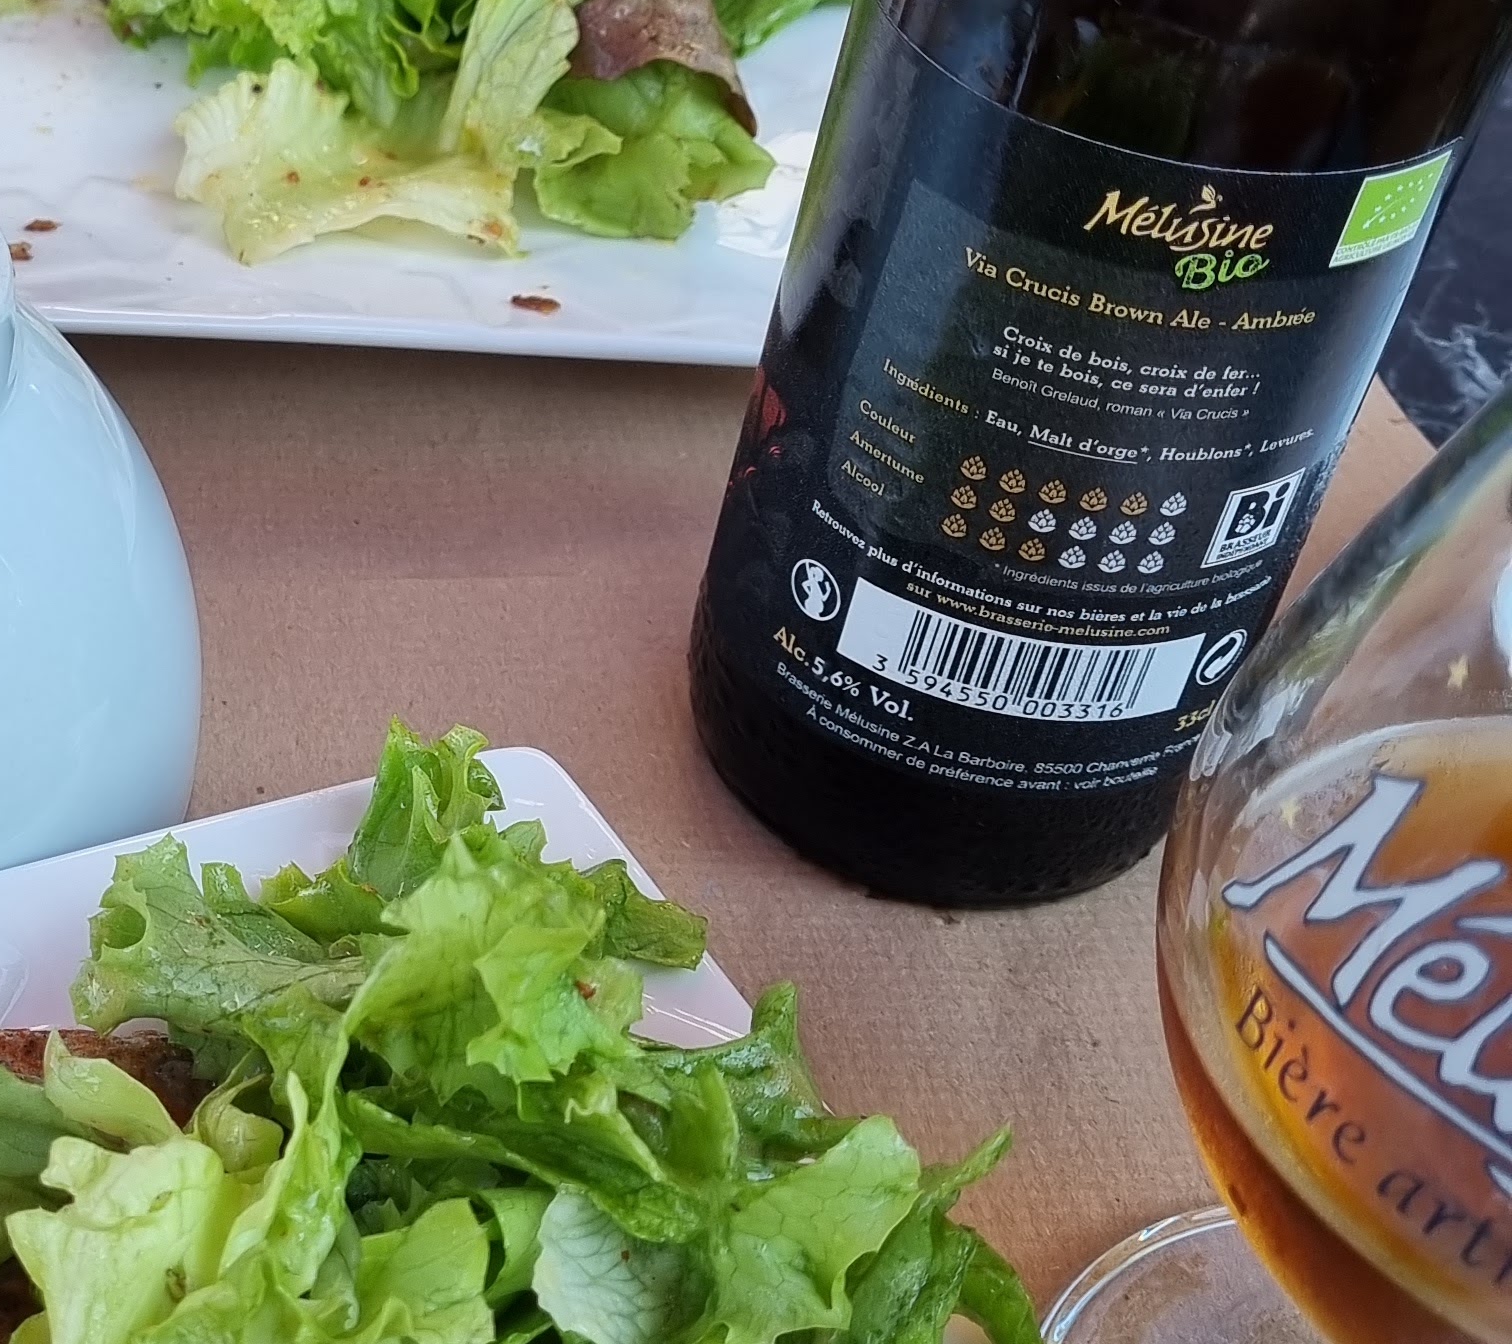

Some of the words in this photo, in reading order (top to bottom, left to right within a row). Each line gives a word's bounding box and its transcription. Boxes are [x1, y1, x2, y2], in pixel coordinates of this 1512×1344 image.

[1084, 187, 1274, 252] Mélusine
[964, 246, 998, 279] Via
[1005, 267, 1081, 307] Crucis
[1088, 292, 1164, 326] Brown
[1170, 308, 1212, 330] Ale
[1231, 306, 1317, 331] Ambrée
[1174, 250, 1270, 290] Bio
[993, 342, 1009, 359] si
[1013, 348, 1031, 367] je
[1037, 357, 1054, 373] te
[1060, 362, 1104, 389] bois,
[1111, 378, 1134, 392] ce
[1139, 382, 1177, 397] sera
[1184, 382, 1249, 399] d'enfer
[1003, 325, 1053, 354] Croix
[1058, 345, 1082, 362] de
[1088, 351, 1133, 375] bois,
[1140, 363, 1188, 379] croix
[1194, 366, 1216, 381] de
[1222, 366, 1261, 381] fer...
[859, 399, 916, 445] Couleur
[883, 358, 969, 415] Ingrédients
[985, 409, 1023, 436] Eau,
[1029, 424, 1073, 448] Malt
[991, 367, 1038, 394] Benoît
[1040, 384, 1101, 411] Grelaud,
[1105, 401, 1153, 417] roman
[1171, 407, 1192, 420] Via
[1196, 408, 1239, 420] Crucis
[840, 459, 886, 496] Alcool
[849, 430, 925, 484] Amertume
[1224, 482, 1291, 541] Bi
[811, 498, 866, 550] Retrouvez
[866, 545, 899, 567] plus
[901, 561, 1012, 608] d'informations
[1016, 599, 1043, 615] sur
[1045, 607, 1075, 620] nos
[1078, 607, 1126, 623] bières
[1130, 610, 1145, 622] et
[1147, 608, 1163, 621] la
[1166, 605, 1188, 619] vie
[1190, 602, 1208, 615] de
[1002, 565, 1079, 592] Ingrédients
[1081, 580, 1118, 594] issus
[1120, 582, 1138, 594] de
[906, 581, 932, 599] sur
[936, 592, 1171, 638] www.brasserie-melusine.com
[776, 661, 833, 710] Brasserie
[835, 703, 900, 742] Mélusine
[934, 745, 954, 760] La
[1033, 762, 1083, 774] 85500
[870, 685, 914, 721] Vol.
[818, 716, 901, 761] consommer
[905, 754, 926, 769] de
[928, 762, 1013, 788] préférence
[1017, 780, 1062, 791] avant
[1074, 778, 1101, 790] voir
[1234, 987, 1366, 1164] Bière
